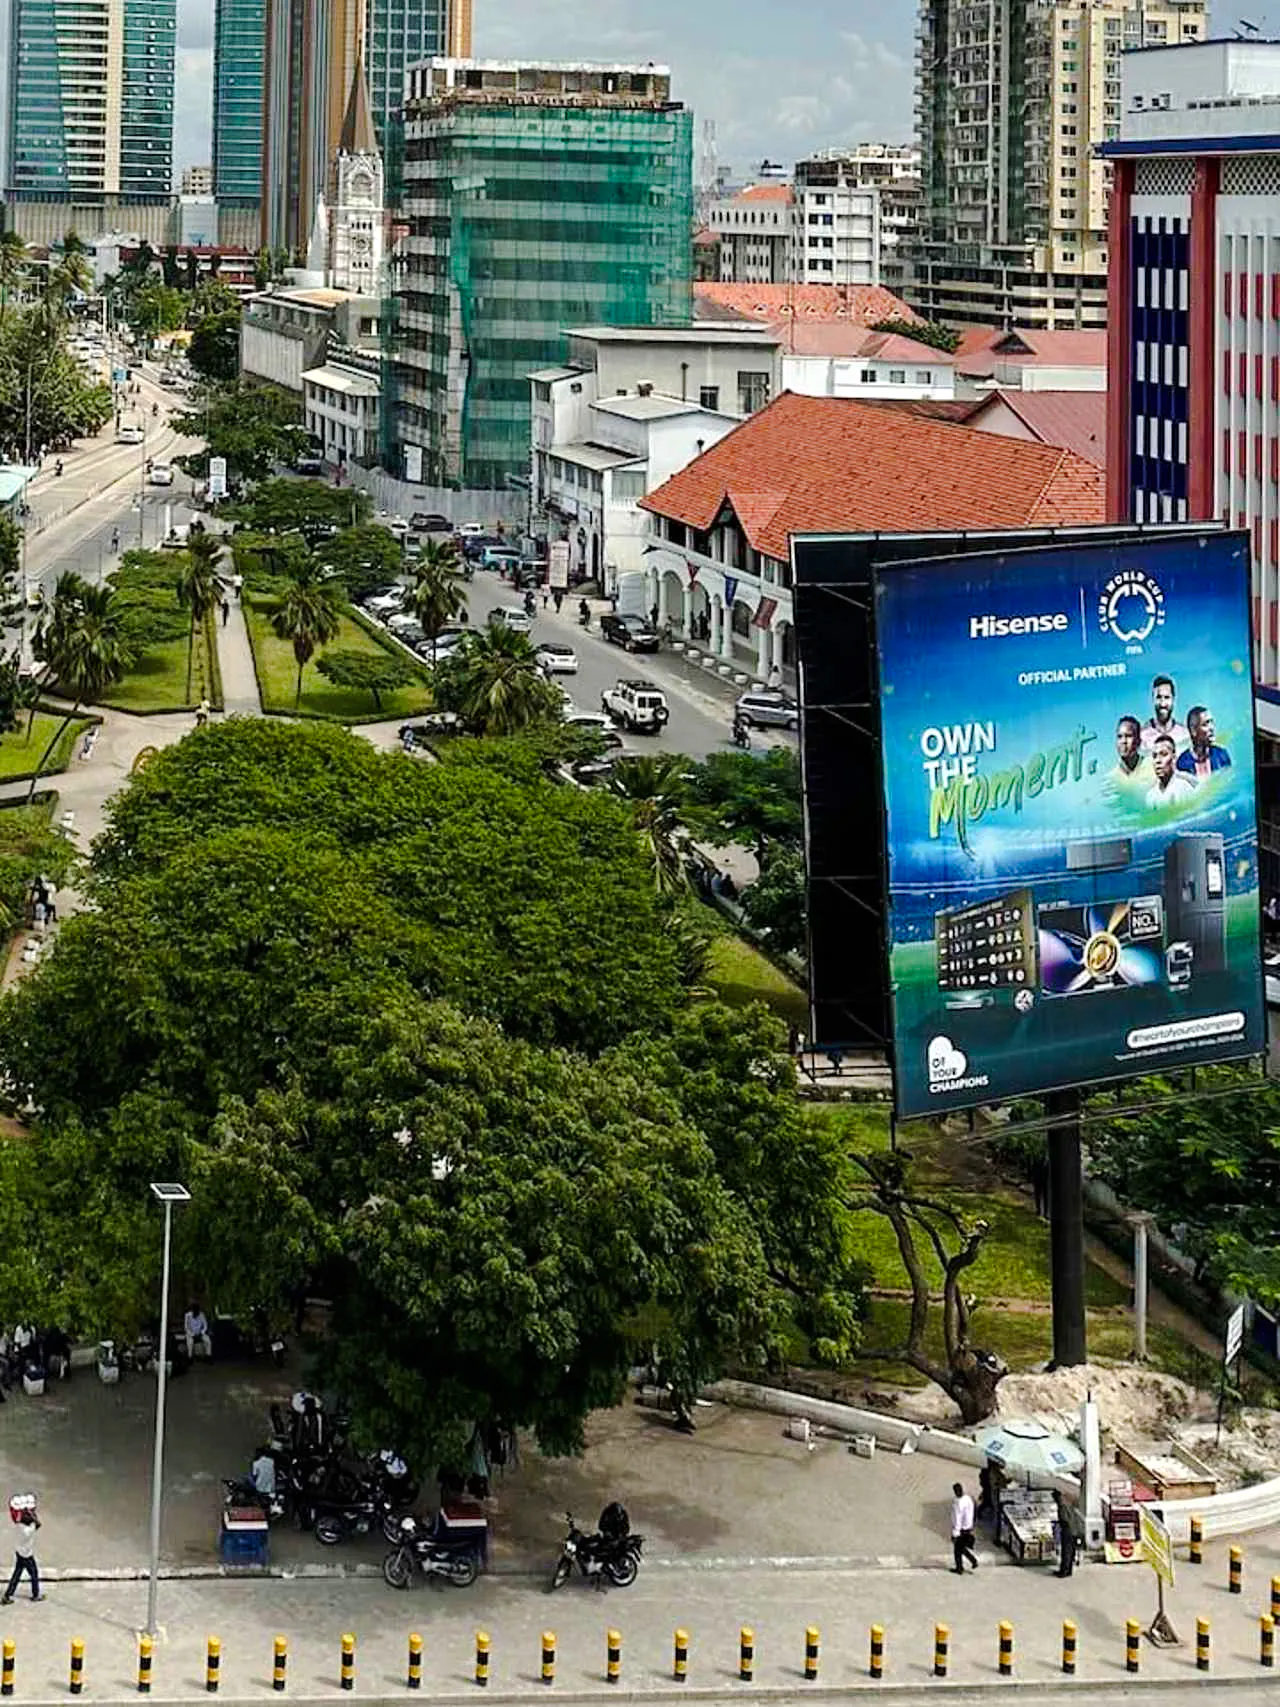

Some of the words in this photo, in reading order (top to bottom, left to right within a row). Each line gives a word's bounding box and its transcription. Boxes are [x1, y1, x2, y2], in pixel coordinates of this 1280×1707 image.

[1099, 595, 1109, 632] CLUB
[1106, 570, 1145, 593] WORLD
[1147, 579, 1164, 603] CUP
[970, 613, 1068, 638] Hisense
[1018, 668, 1072, 685] OFFICIAL
[1073, 663, 1127, 680] PARTNER
[921, 721, 996, 759] OWN
[923, 757, 978, 791] THE
[928, 1075, 989, 1093] CHAMPIONS
